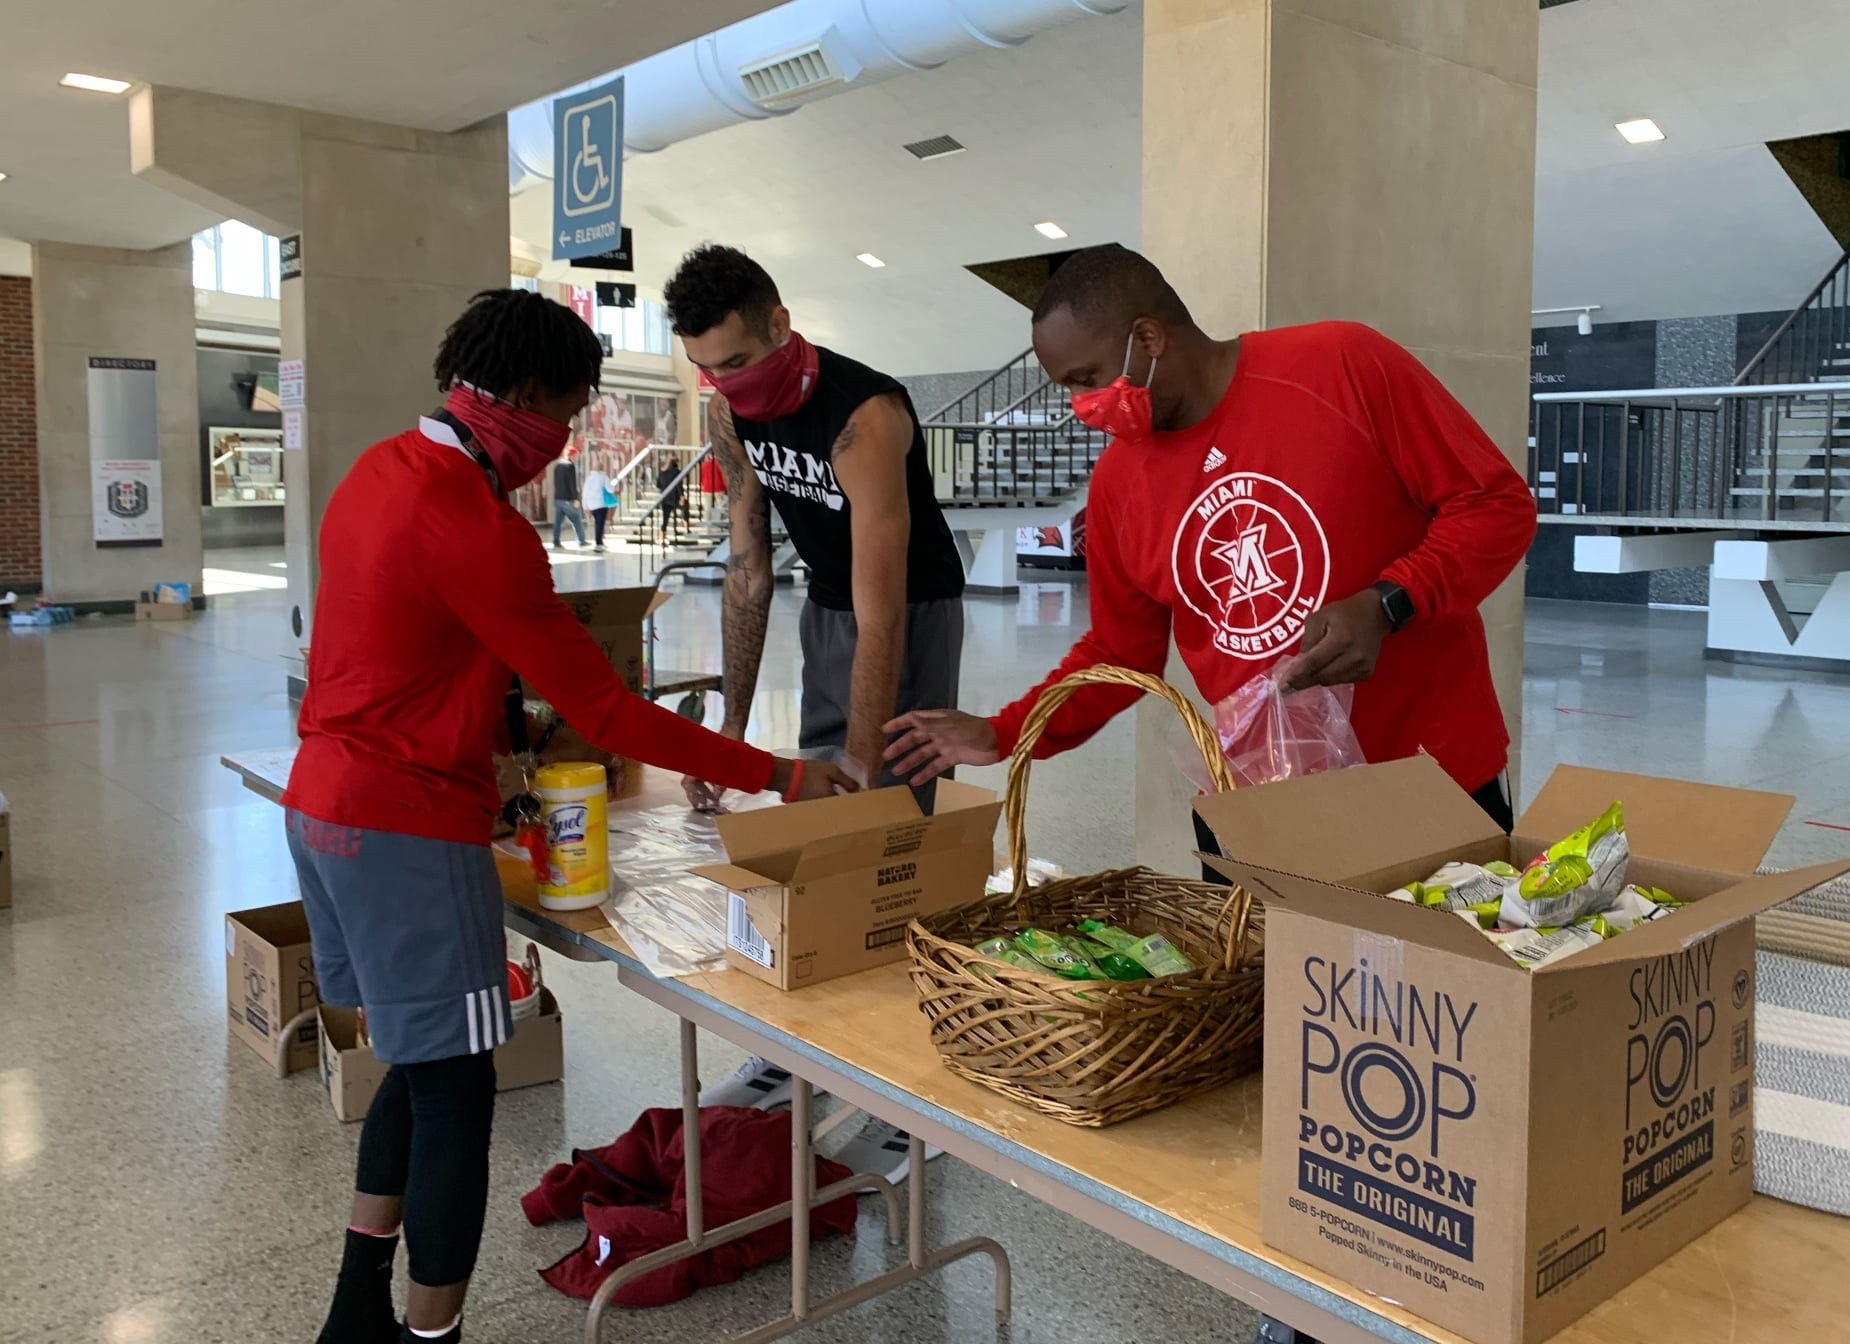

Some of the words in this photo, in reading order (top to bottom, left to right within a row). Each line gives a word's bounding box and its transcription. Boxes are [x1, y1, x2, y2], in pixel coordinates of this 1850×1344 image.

[575, 221, 616, 244] ELEVATOR
[743, 439, 842, 494] MIAMI
[1216, 595, 1315, 653] ASKETBALL
[877, 870, 917, 887] BAKERY
[1302, 1019, 1477, 1158] POP
[1625, 1000, 1716, 1130] POP
[1299, 1114, 1477, 1208] POPCORN
[1623, 1086, 1715, 1165] POPCORN
[1303, 1159, 1345, 1197] THE
[1353, 1181, 1467, 1248] ORIGINAL
[1625, 1169, 1649, 1201] THE
[1653, 1133, 1711, 1185] ORIGINAL
[1288, 1196, 1308, 1213] 888
[1309, 1205, 1370, 1241] 5-POPCORN
[1377, 1236, 1485, 1291] www.skinnypop.com
[1318, 1225, 1355, 1251] Popped
[1357, 1240, 1391, 1267] Skinny
[1392, 1259, 1402, 1271] in
[1405, 1264, 1422, 1280] the
[1424, 1272, 1448, 1292] USA
